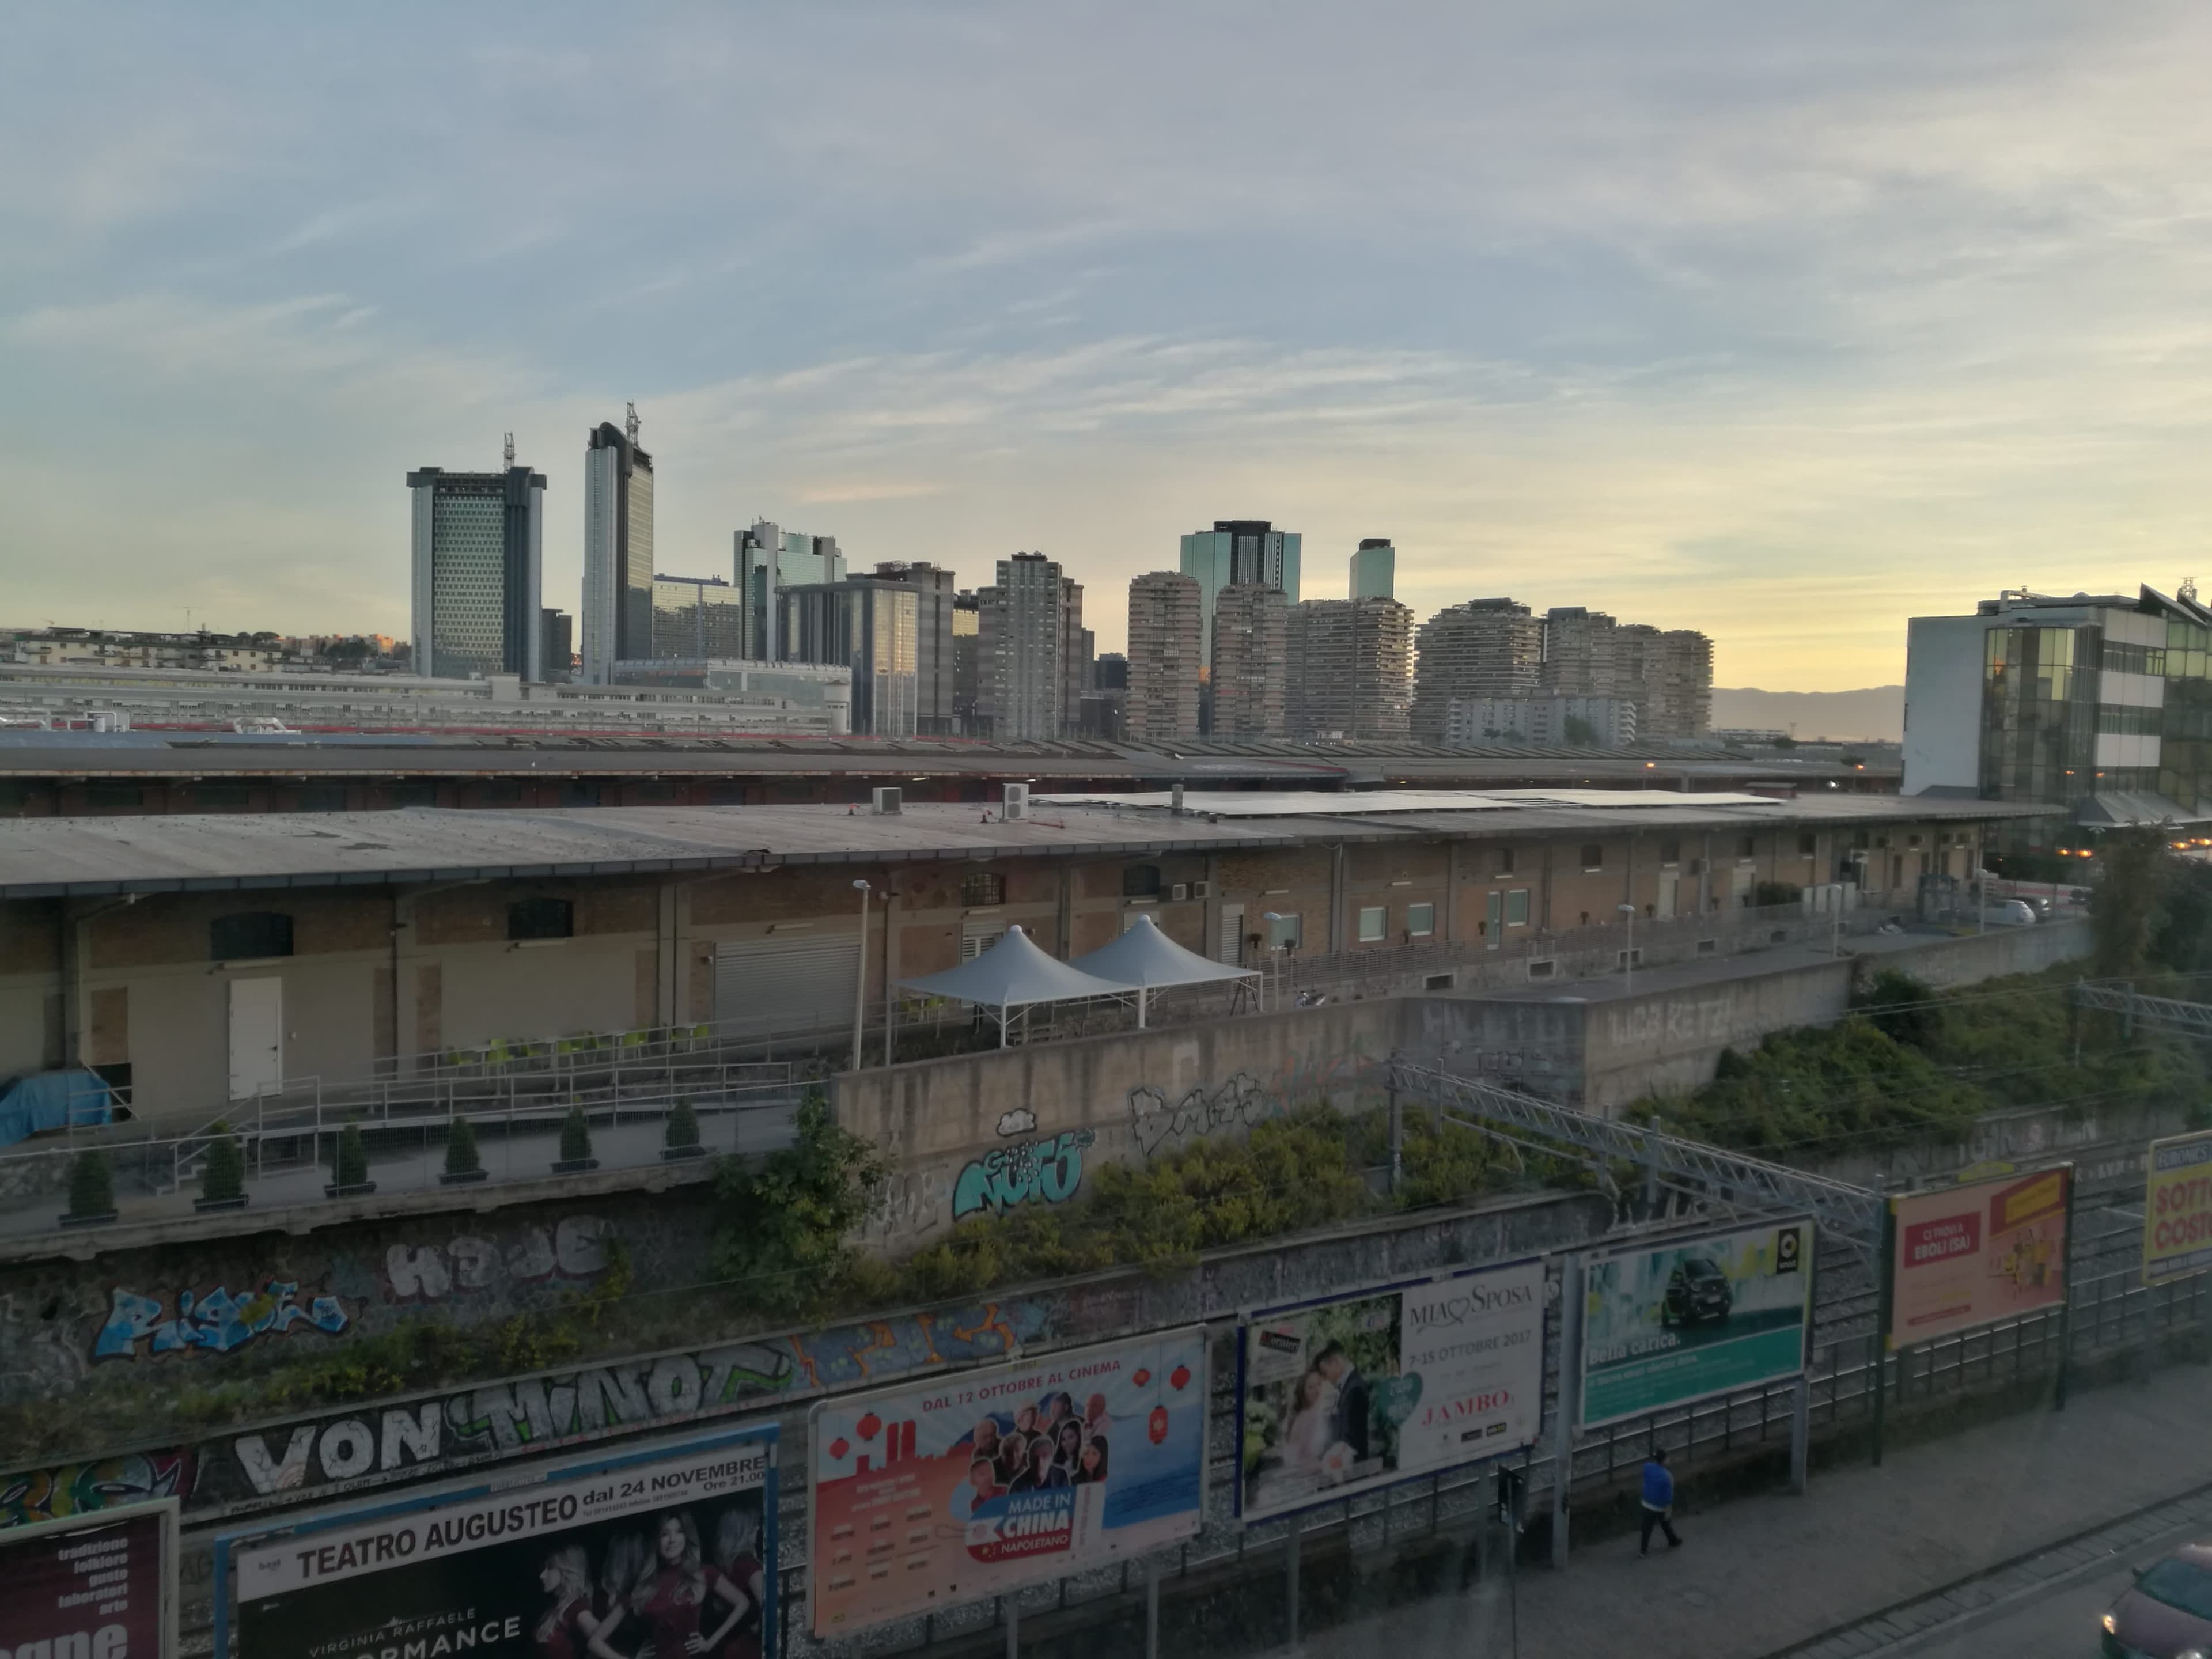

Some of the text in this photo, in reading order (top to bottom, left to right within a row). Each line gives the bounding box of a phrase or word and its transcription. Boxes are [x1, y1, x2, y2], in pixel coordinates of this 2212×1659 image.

[2156, 1176, 2212, 1214] SOTT
[1411, 1301, 1448, 1326] MIA
[1439, 1336, 1499, 1362] OTTOBRE
[1503, 1329, 1532, 1347] 2017
[1588, 1342, 1627, 1365] Bella
[923, 1359, 1120, 1412] DAL 12 OTTOBRE AL CINEMA
[235, 1402, 441, 1494] VON
[703, 1471, 765, 1492] Ore 21.00
[1008, 1492, 1071, 1514] MADE IN
[296, 1456, 766, 1578] TEATRO AUGUSTEO dal 24 NOVEMBRE
[1003, 1509, 1070, 1539] CHINA
[58, 1537, 129, 1562] tradizione
[1001, 1535, 1069, 1554] NAPOLETANO
[74, 1553, 129, 1575] folklore
[89, 1569, 128, 1588] gusto
[58, 1582, 128, 1609] laboratori
[99, 1600, 128, 1616] arte
[309, 1608, 476, 1658] VIRGINIA RAFFAELE
